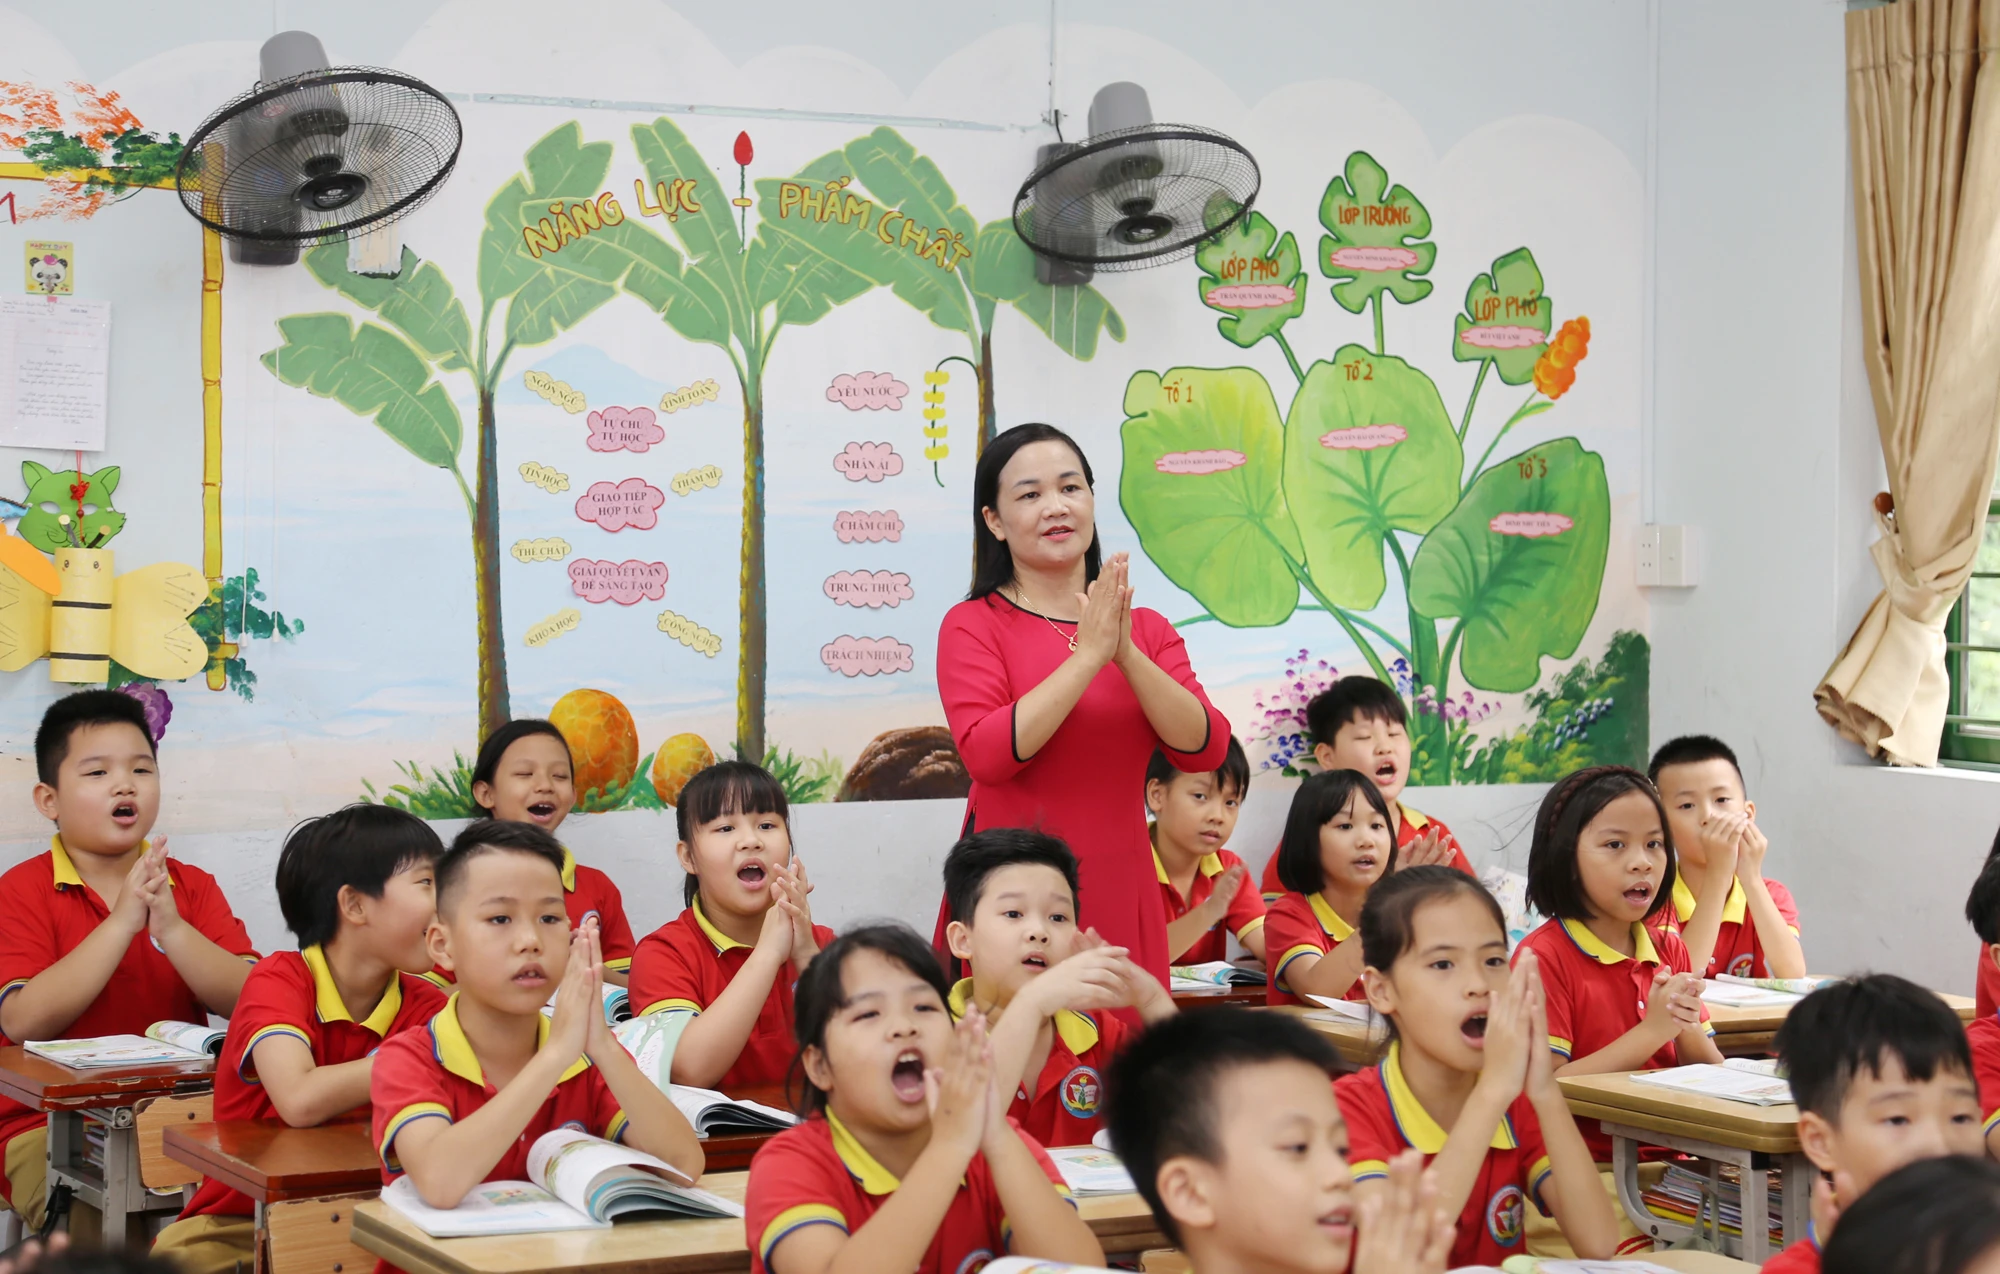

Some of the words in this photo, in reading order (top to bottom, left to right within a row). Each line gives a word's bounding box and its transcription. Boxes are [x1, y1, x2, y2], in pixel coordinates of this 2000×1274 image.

[523, 191, 625, 259] NĂNG
[634, 178, 701, 223] LỰC
[779, 176, 872, 231] PHẨM
[877, 210, 972, 272] CHẤT
[1363, 363, 1373, 380] 2
[837, 385, 860, 397] YÊU
[1186, 385, 1192, 403] 1
[620, 432, 643, 444] HỌC
[1538, 458, 1547, 478] 3
[592, 493, 621, 502] GIAO
[830, 582, 868, 592] TRUNG
